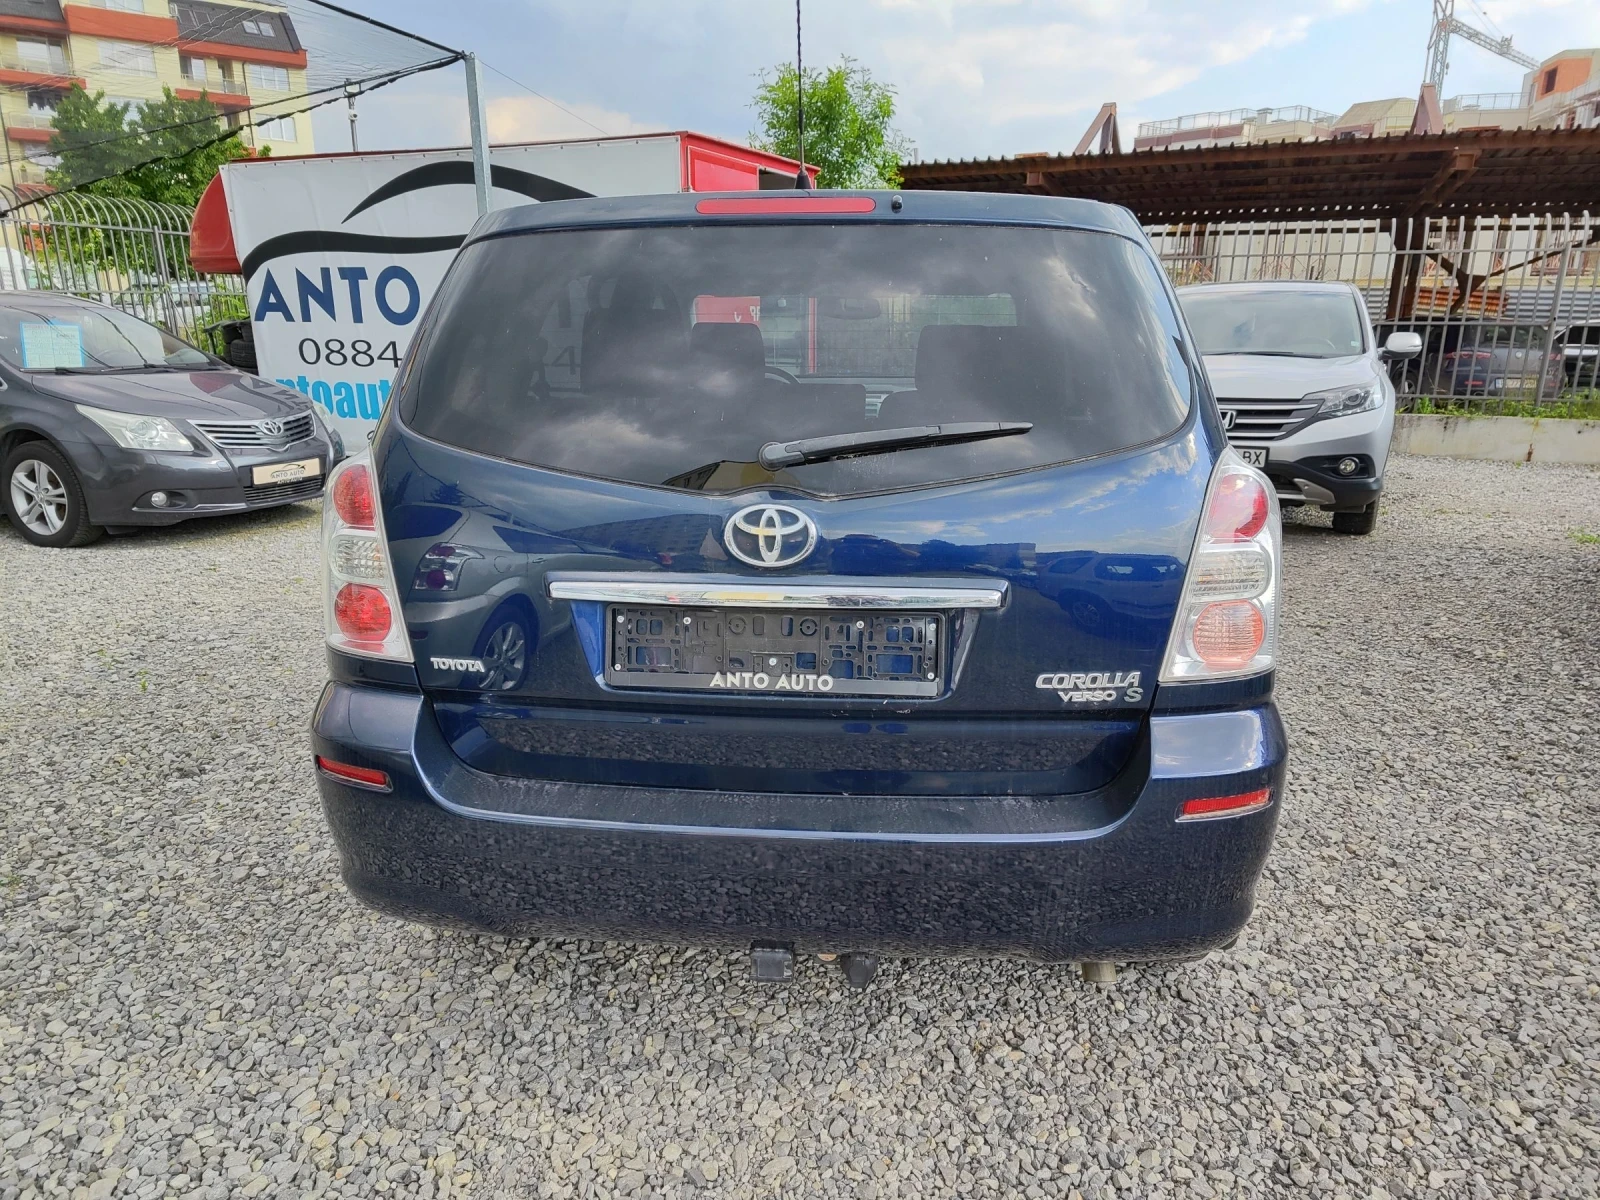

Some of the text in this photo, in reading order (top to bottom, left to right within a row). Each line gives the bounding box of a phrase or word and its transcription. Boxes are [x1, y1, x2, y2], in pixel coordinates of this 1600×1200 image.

[254, 265, 421, 326] ANTO
[298, 338, 402, 368] 0884
[430, 657, 485, 672] TOYOTA
[709, 671, 833, 691] ANTO AUTO
[1035, 671, 1141, 689] COROLLA
[1058, 687, 1144, 703] VERSO S
